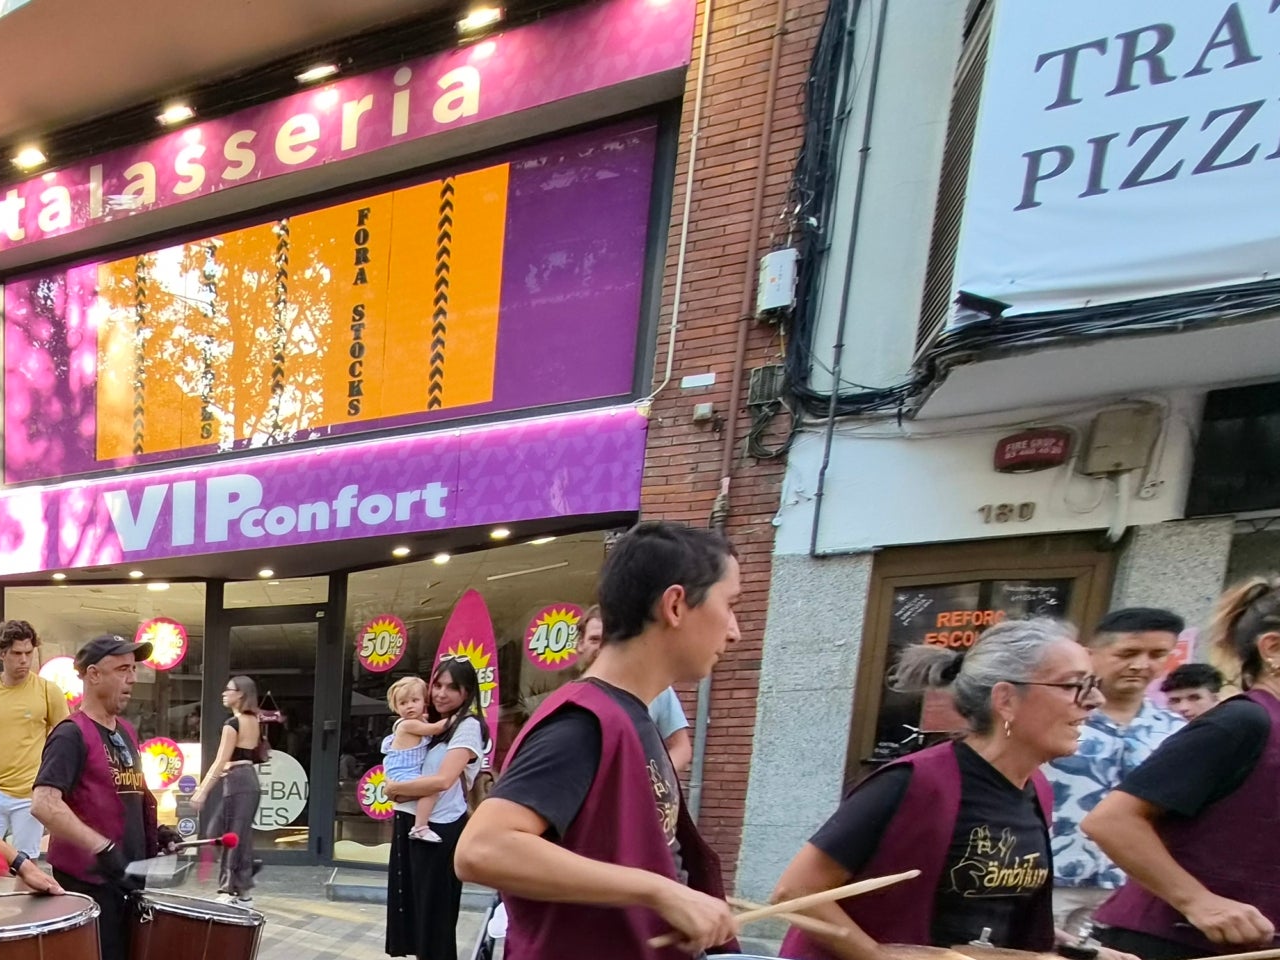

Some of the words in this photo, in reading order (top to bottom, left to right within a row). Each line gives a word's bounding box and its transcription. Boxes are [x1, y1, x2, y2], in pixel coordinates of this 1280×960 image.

[1034, 2, 1280, 111] TRA
[1012, 98, 1280, 212] PIZZ
[352, 207, 371, 286] FORA
[347, 304, 366, 417] STOCKS
[977, 502, 1036, 524] 180
[359, 629, 404, 658] 50%
[926, 631, 980, 648] ESCO
